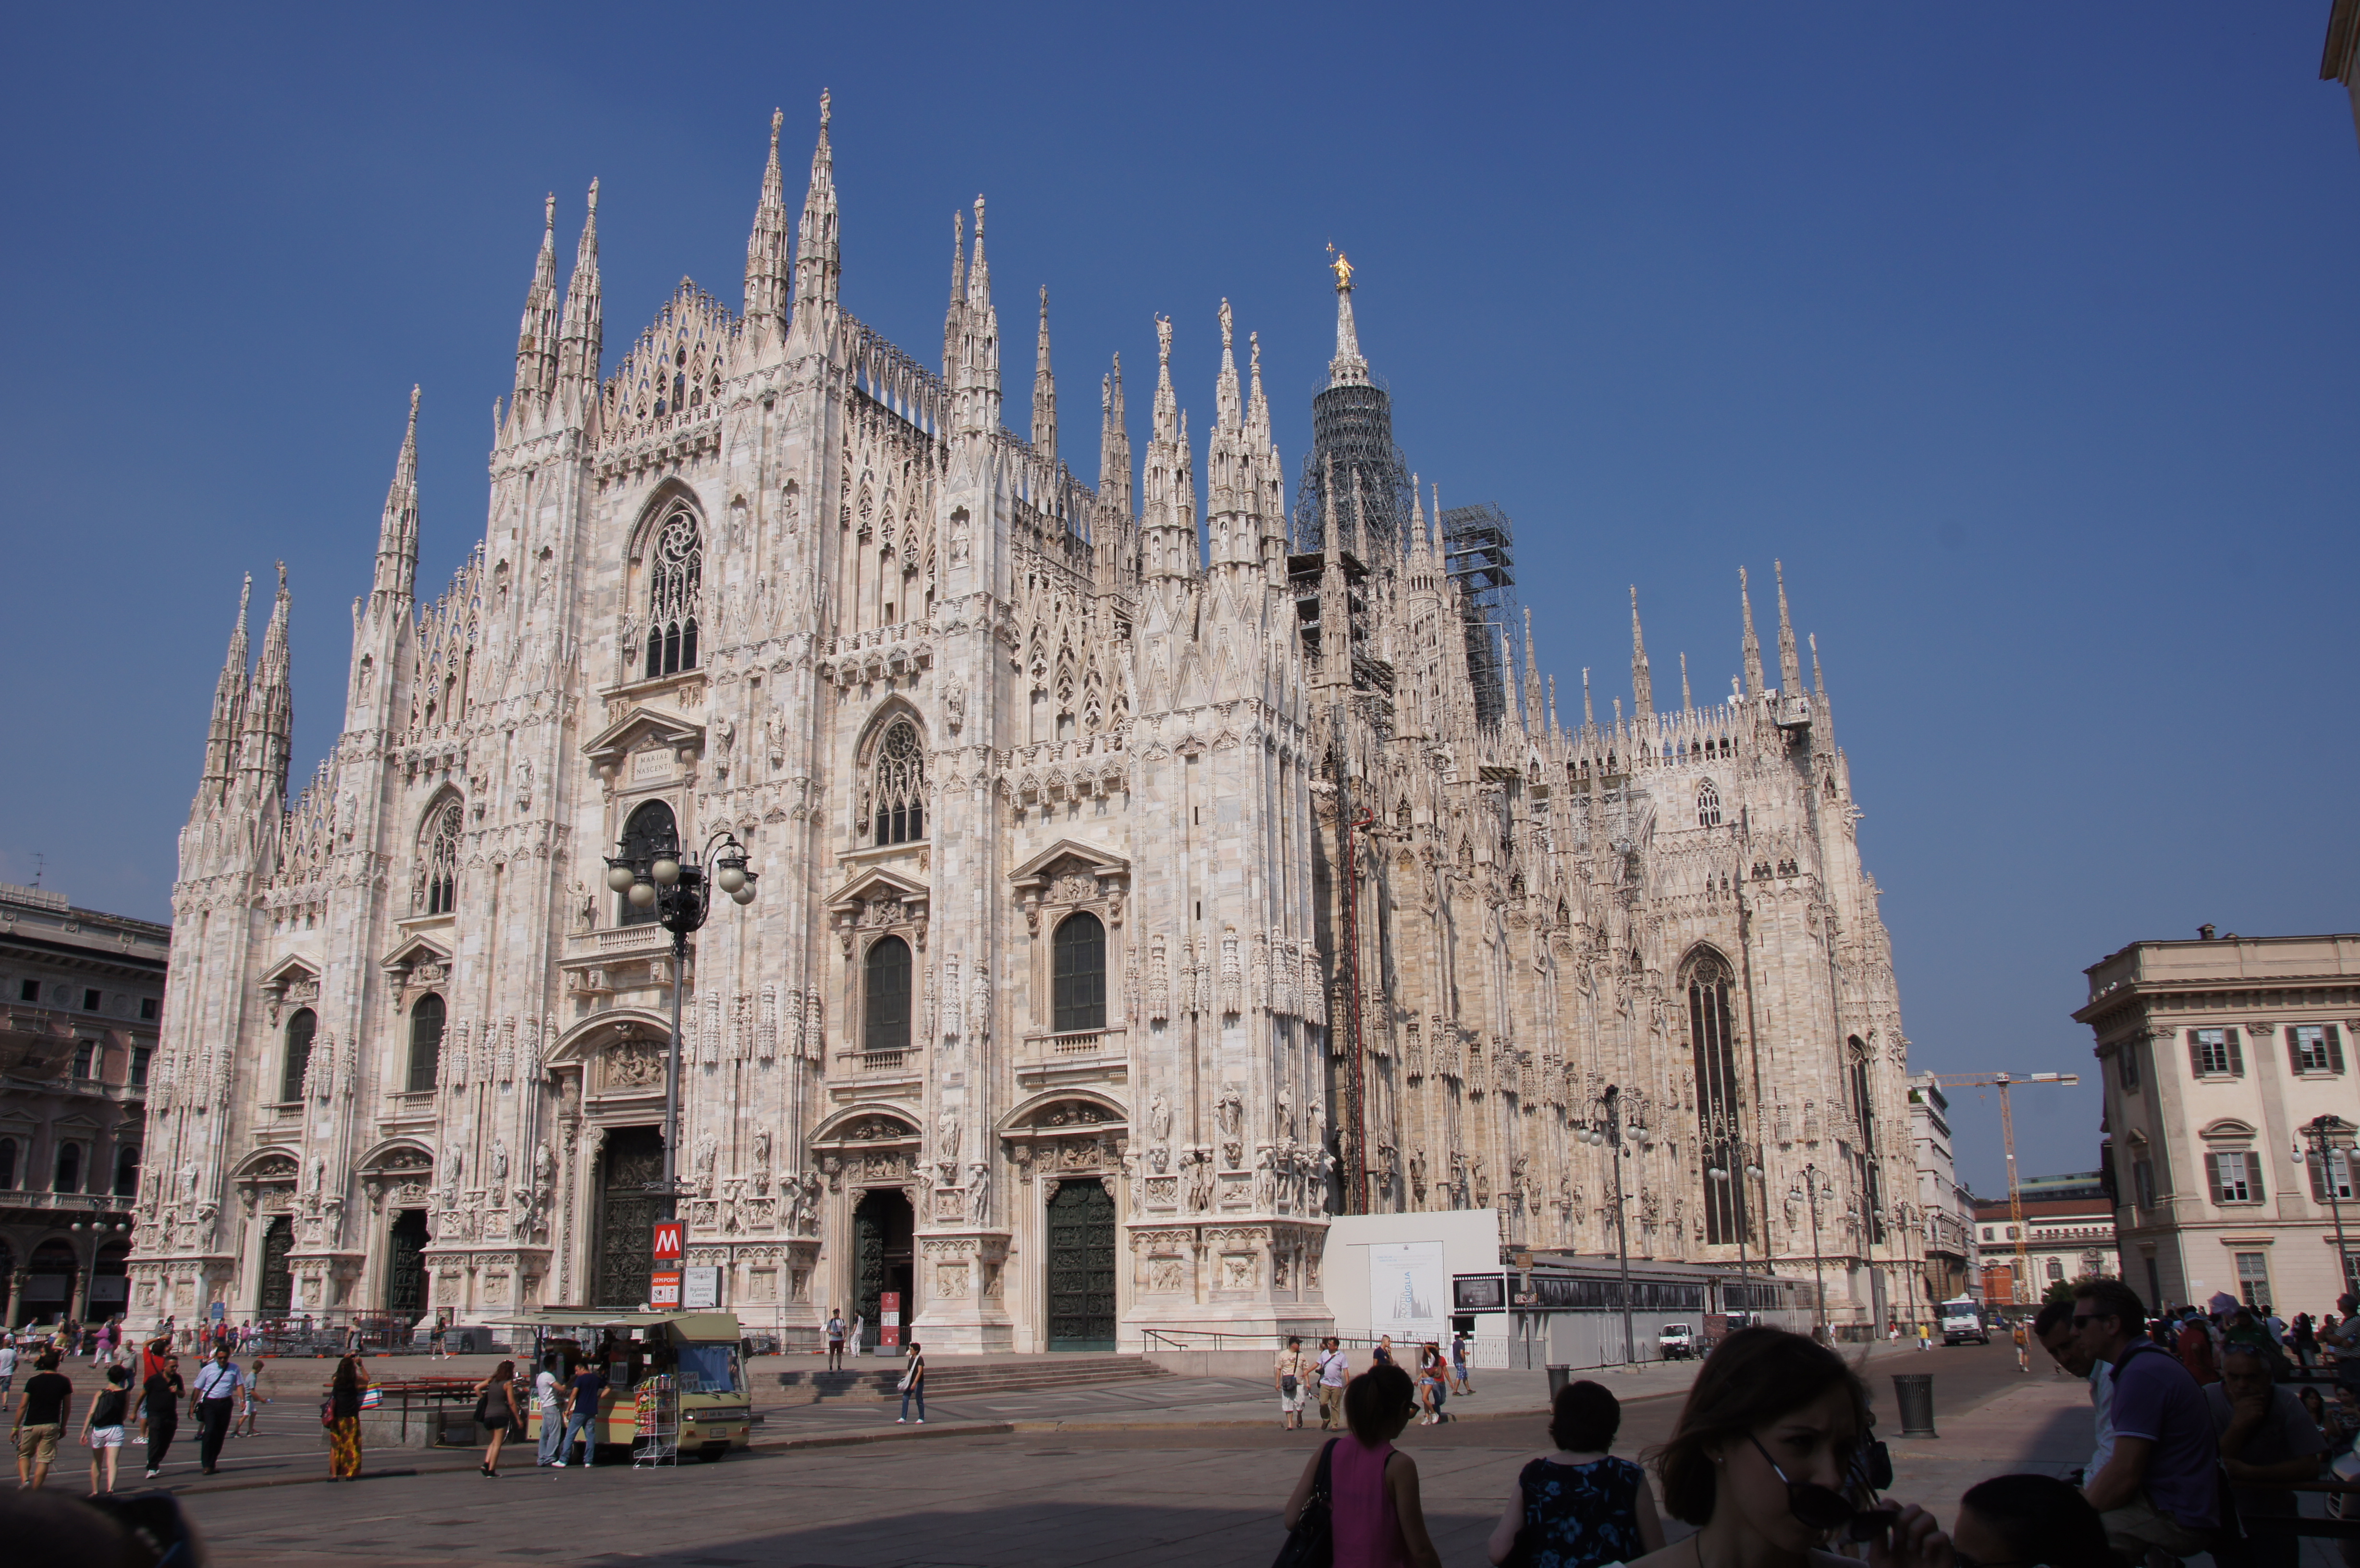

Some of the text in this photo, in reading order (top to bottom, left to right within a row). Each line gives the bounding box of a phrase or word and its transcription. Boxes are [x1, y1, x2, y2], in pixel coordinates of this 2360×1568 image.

[640, 752, 668, 763] MARIAE
[637, 763, 671, 775] NASCENTI
[655, 1229, 679, 1252] M
